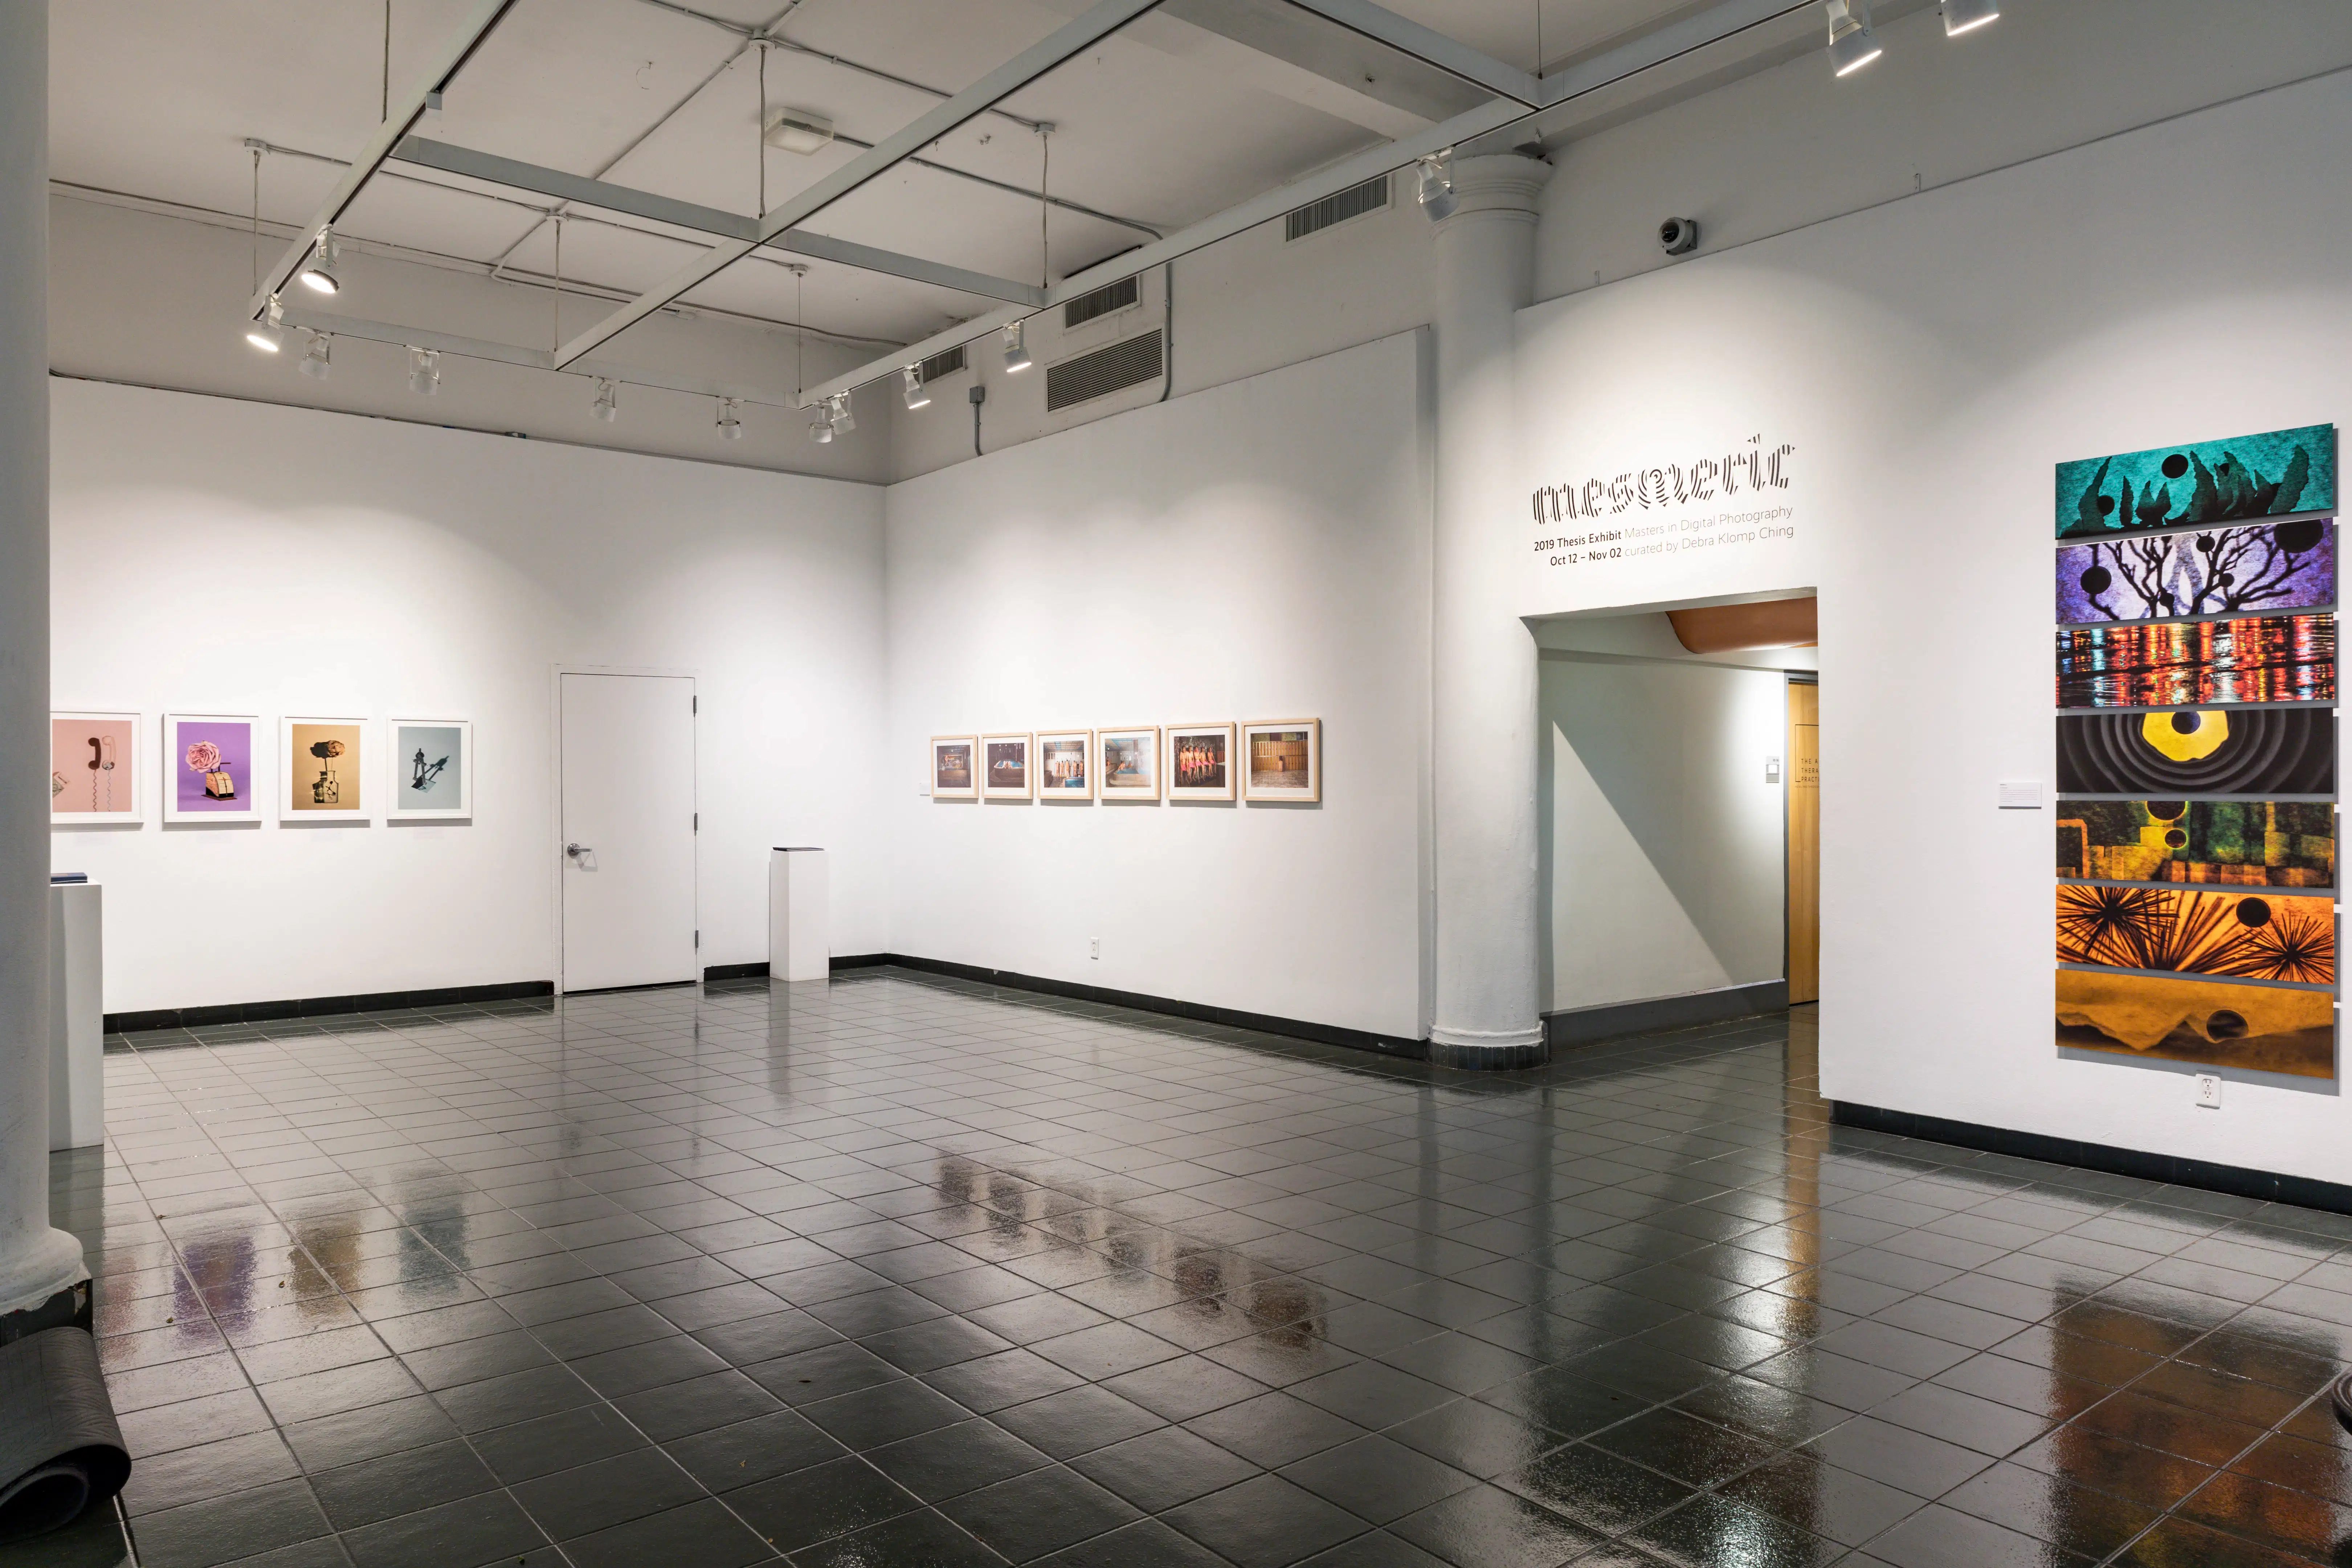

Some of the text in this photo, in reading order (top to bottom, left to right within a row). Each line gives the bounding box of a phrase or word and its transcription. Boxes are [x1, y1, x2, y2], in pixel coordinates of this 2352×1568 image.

[1534, 506, 1793, 551] 2019 Thesis Exhibit Masters in Digital Photography
[1551, 556, 1565, 566] Oct
[1568, 554, 1577, 564] 12
[1589, 551, 1607, 561] Nov
[1610, 547, 1621, 558] 02
[1625, 542, 1662, 556] curated
[1666, 541, 1678, 553] by
[1682, 536, 1714, 549] Debra
[1719, 532, 1755, 544] Klomp
[1760, 527, 1793, 538] Ching
